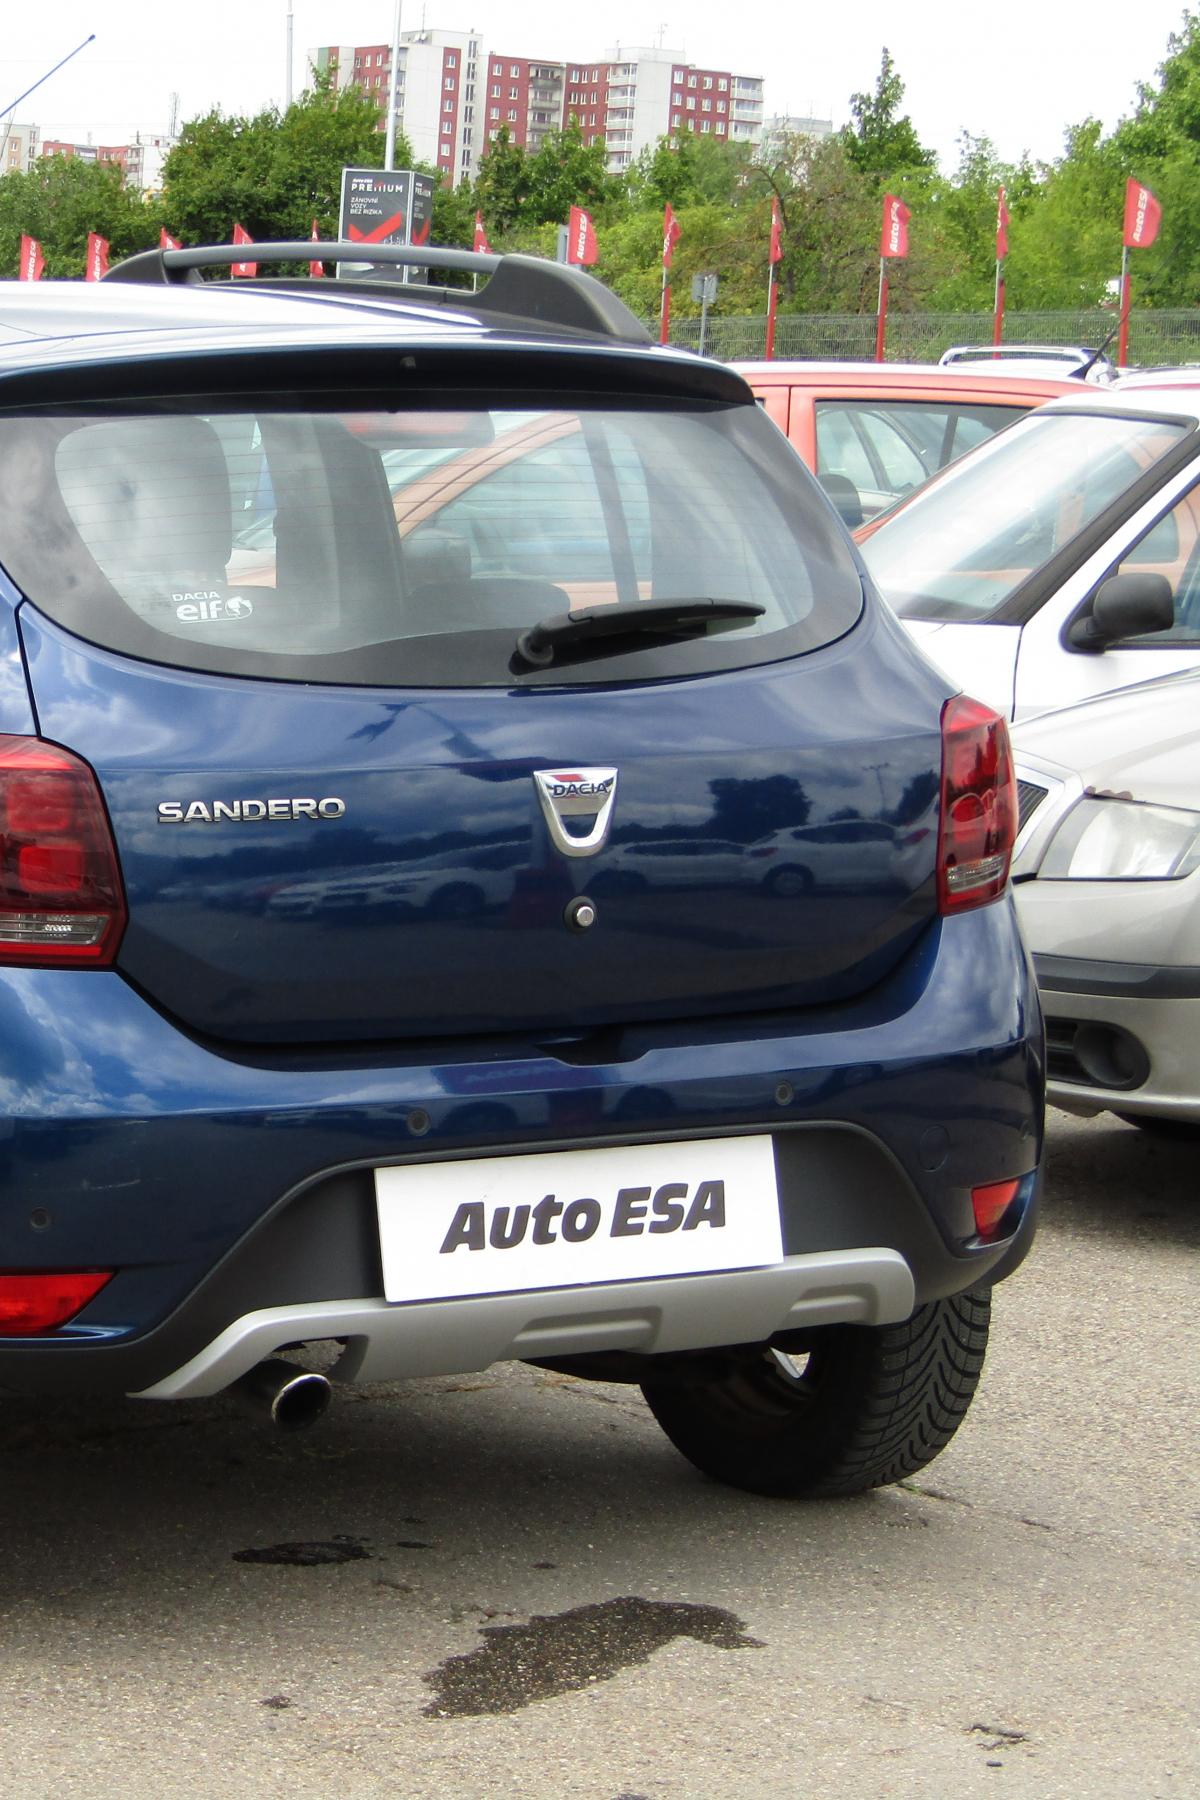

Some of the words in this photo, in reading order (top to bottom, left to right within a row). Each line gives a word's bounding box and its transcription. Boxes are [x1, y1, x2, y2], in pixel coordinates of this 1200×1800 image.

[351, 181, 403, 193] PREMIUM
[890, 222, 899, 253] Auto
[1132, 210, 1145, 242] Auto
[577, 232, 586, 260] Auto
[172, 591, 220, 602] DACIA
[176, 601, 222, 621] elf
[553, 783, 608, 797] DACIA
[158, 797, 346, 822] SANDERO
[439, 1194, 601, 1254] Auto
[610, 1180, 726, 1238] ESA
